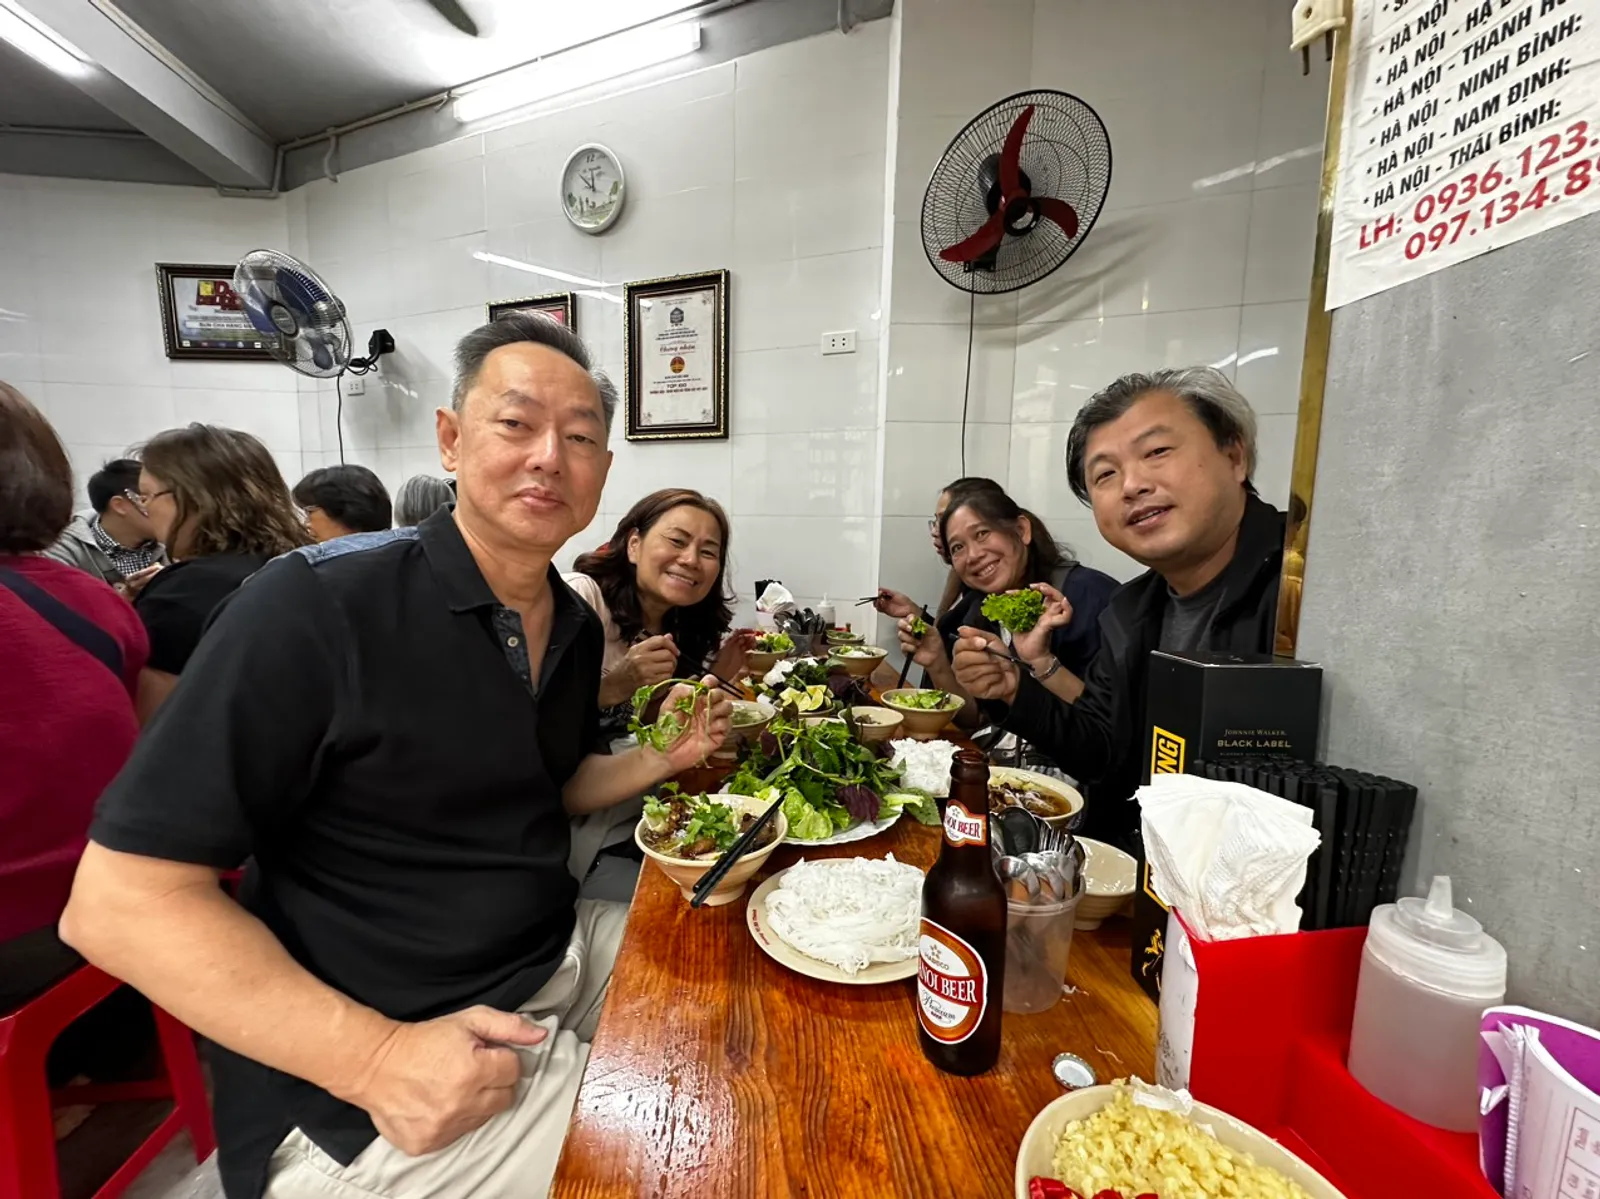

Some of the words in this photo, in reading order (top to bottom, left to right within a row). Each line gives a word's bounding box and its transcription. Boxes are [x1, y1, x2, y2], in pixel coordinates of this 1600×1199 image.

[1383, 88, 1405, 117] HÀ
[1410, 64, 1442, 99] NỘI
[1462, 5, 1533, 66] THANH
[1386, 55, 1408, 86] HÀ
[1414, 31, 1446, 67] NỘI
[1465, 0, 1493, 32] HẠ
[1389, 24, 1411, 55] HÀ
[1416, 0, 1448, 35] NỘI
[1380, 118, 1401, 147] HÀ
[1407, 99, 1438, 132] NỘI
[1458, 55, 1510, 102] NINH
[1516, 14, 1583, 67] BÌNH:
[1376, 150, 1398, 178] HÀ
[1403, 132, 1434, 163] NỘI
[1452, 94, 1501, 137] NAM
[1507, 57, 1572, 106] ĐỊNH:
[1373, 182, 1395, 208] HÀ
[1400, 167, 1430, 196] NỘI
[1449, 132, 1493, 170] THÁI
[1499, 98, 1562, 144] BÌNH:
[1359, 213, 1403, 250] LH:
[1217, 739, 1253, 748] BLACK
[1256, 739, 1292, 748] LABEL
[957, 821, 980, 839] BEER
[940, 976, 977, 1003] BEER
